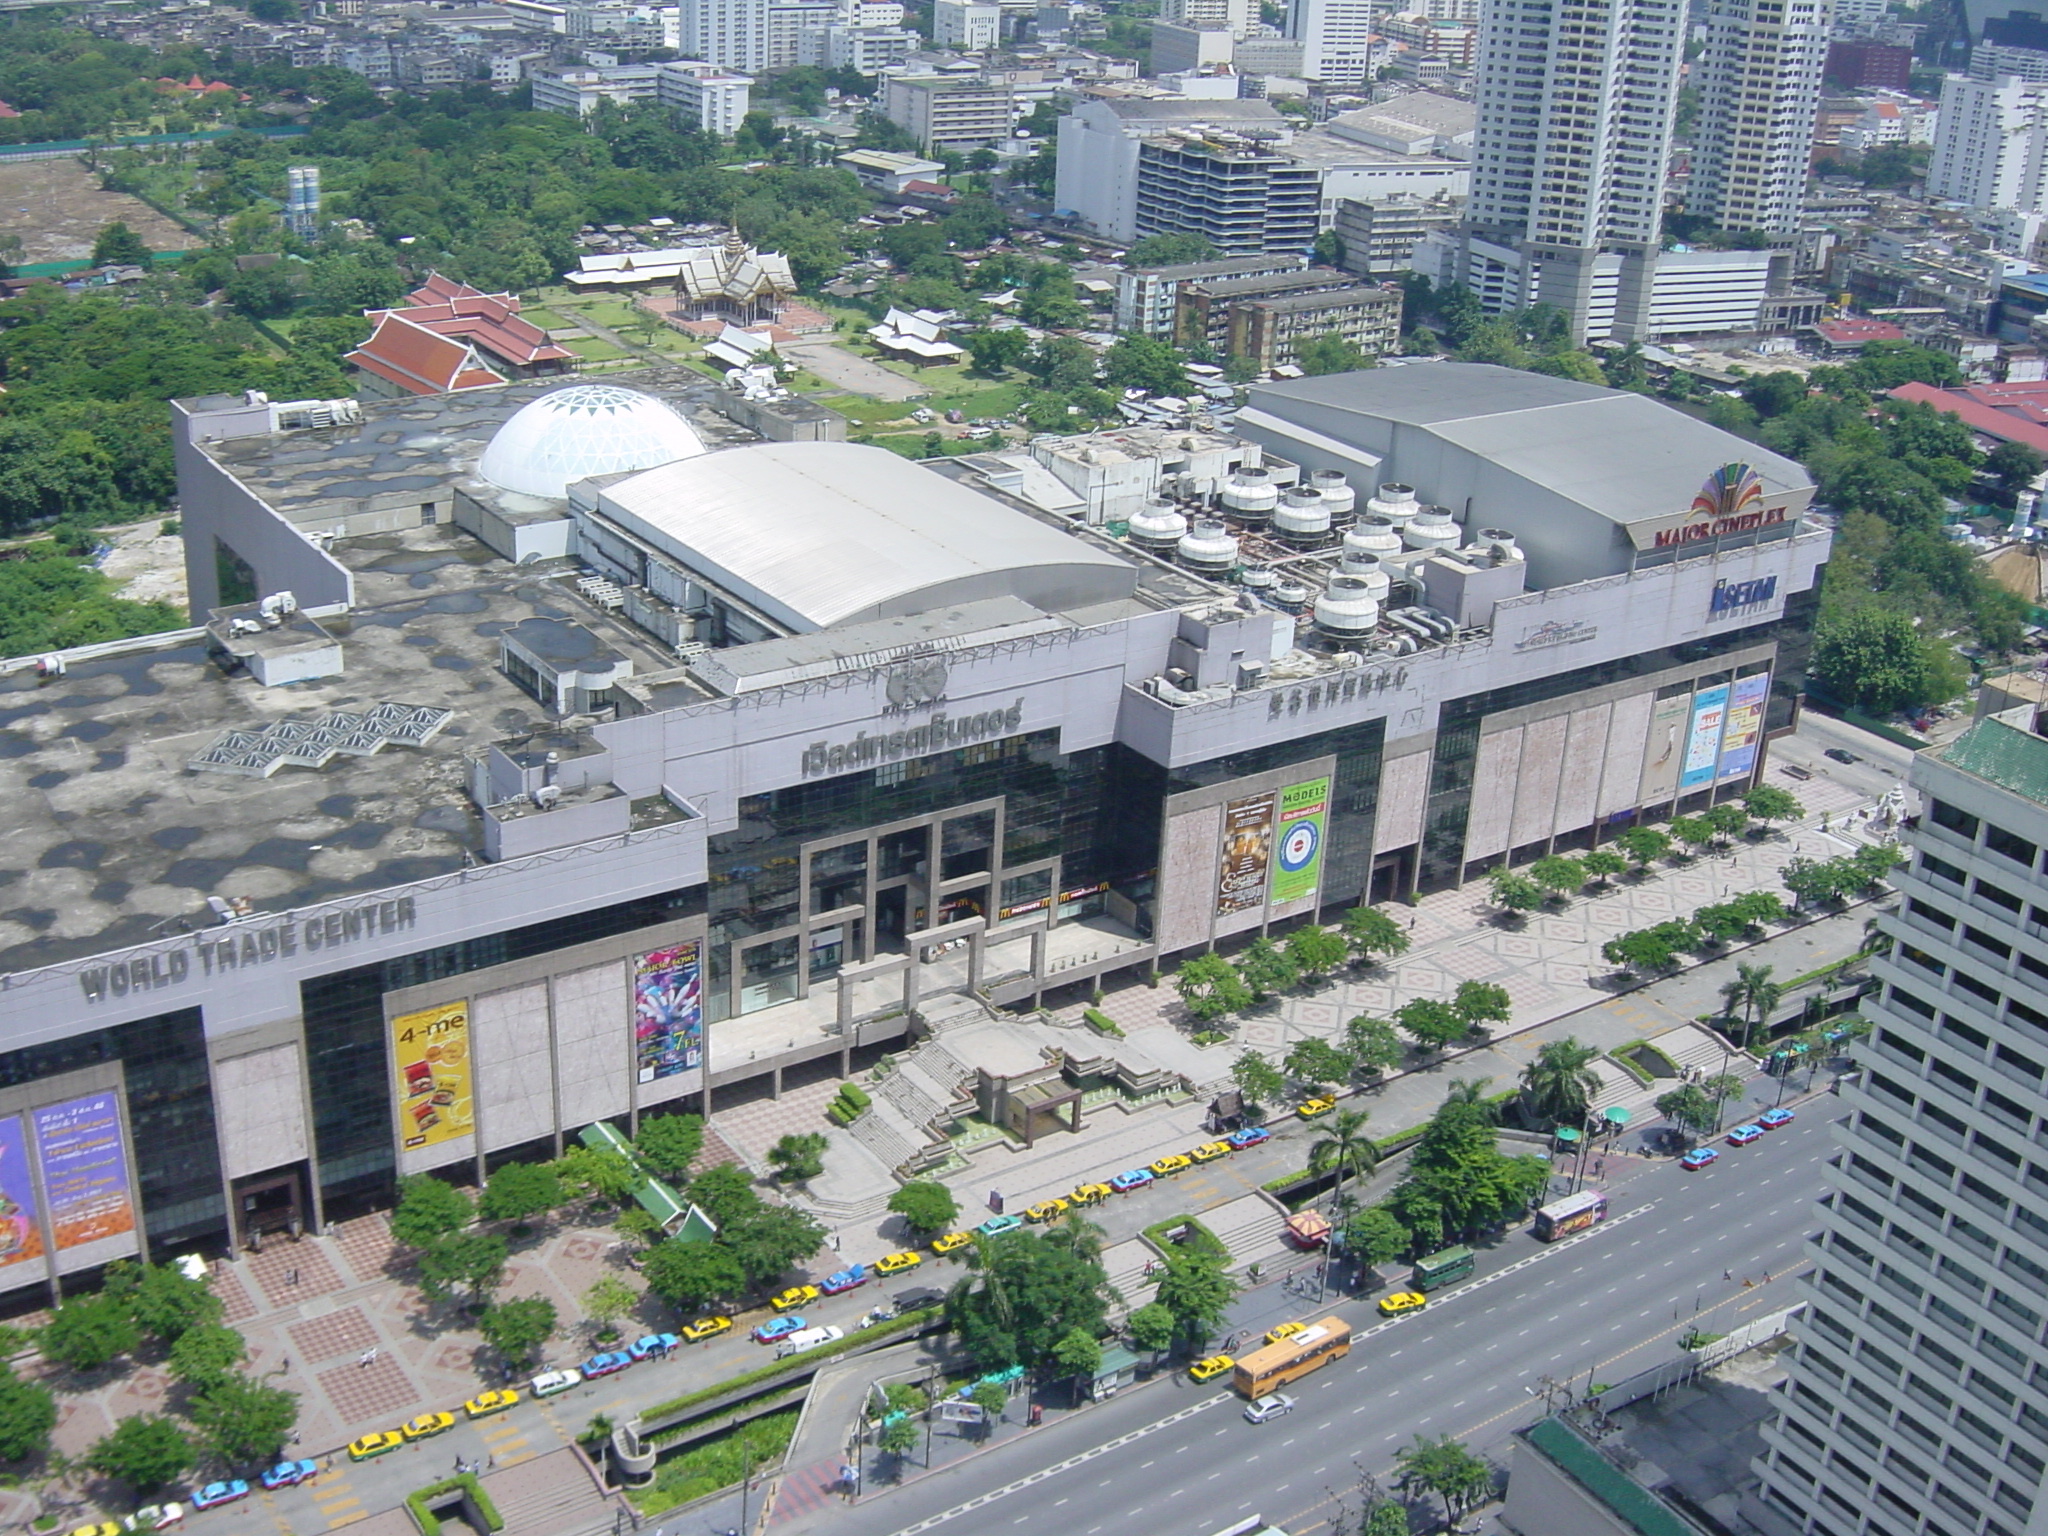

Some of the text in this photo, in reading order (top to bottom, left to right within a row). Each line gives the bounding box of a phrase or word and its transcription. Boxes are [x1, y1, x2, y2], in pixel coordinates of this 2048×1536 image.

[1655, 506, 1787, 547] MAJOR CINEPLEX
[80, 896, 416, 1003] WORLD TRADE CENTER
[399, 1014, 465, 1043] 4-me
[673, 1030, 685, 1051] 7
